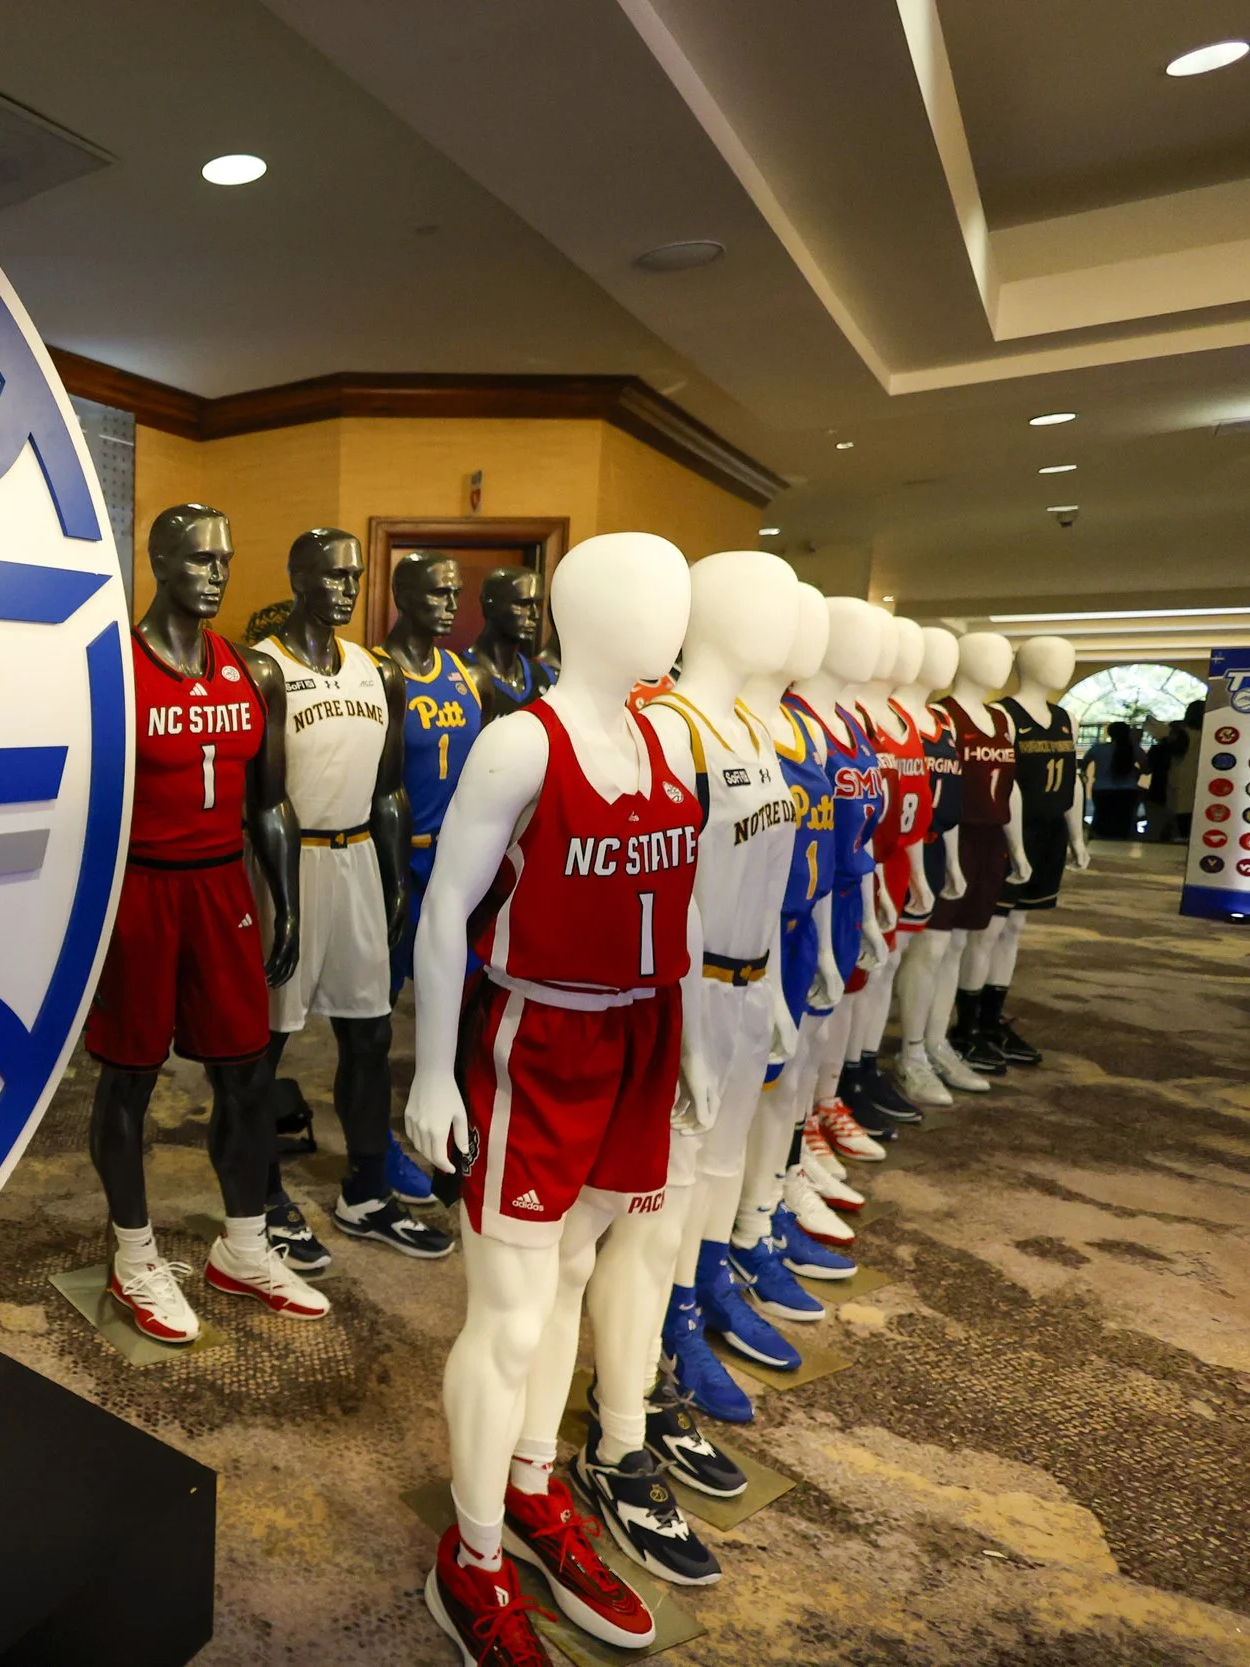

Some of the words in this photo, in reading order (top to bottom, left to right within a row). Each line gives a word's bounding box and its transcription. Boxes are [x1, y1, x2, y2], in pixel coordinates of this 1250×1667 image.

[148, 706, 183, 737] NC
[189, 702, 252, 734] STATE
[293, 700, 344, 734] NOTRE
[344, 699, 384, 726] DAME
[408, 695, 467, 730] Pitt
[438, 733, 449, 780] 1
[1044, 758, 1065, 793] 11
[200, 743, 217, 811] 1
[990, 768, 1001, 803] 1
[734, 803, 781, 846] NOTRE
[564, 837, 621, 877] NC
[625, 826, 697, 875] STATE
[805, 840, 818, 900] 1
[637, 892, 656, 978] 1
[512, 1199, 544, 1212] adidas
